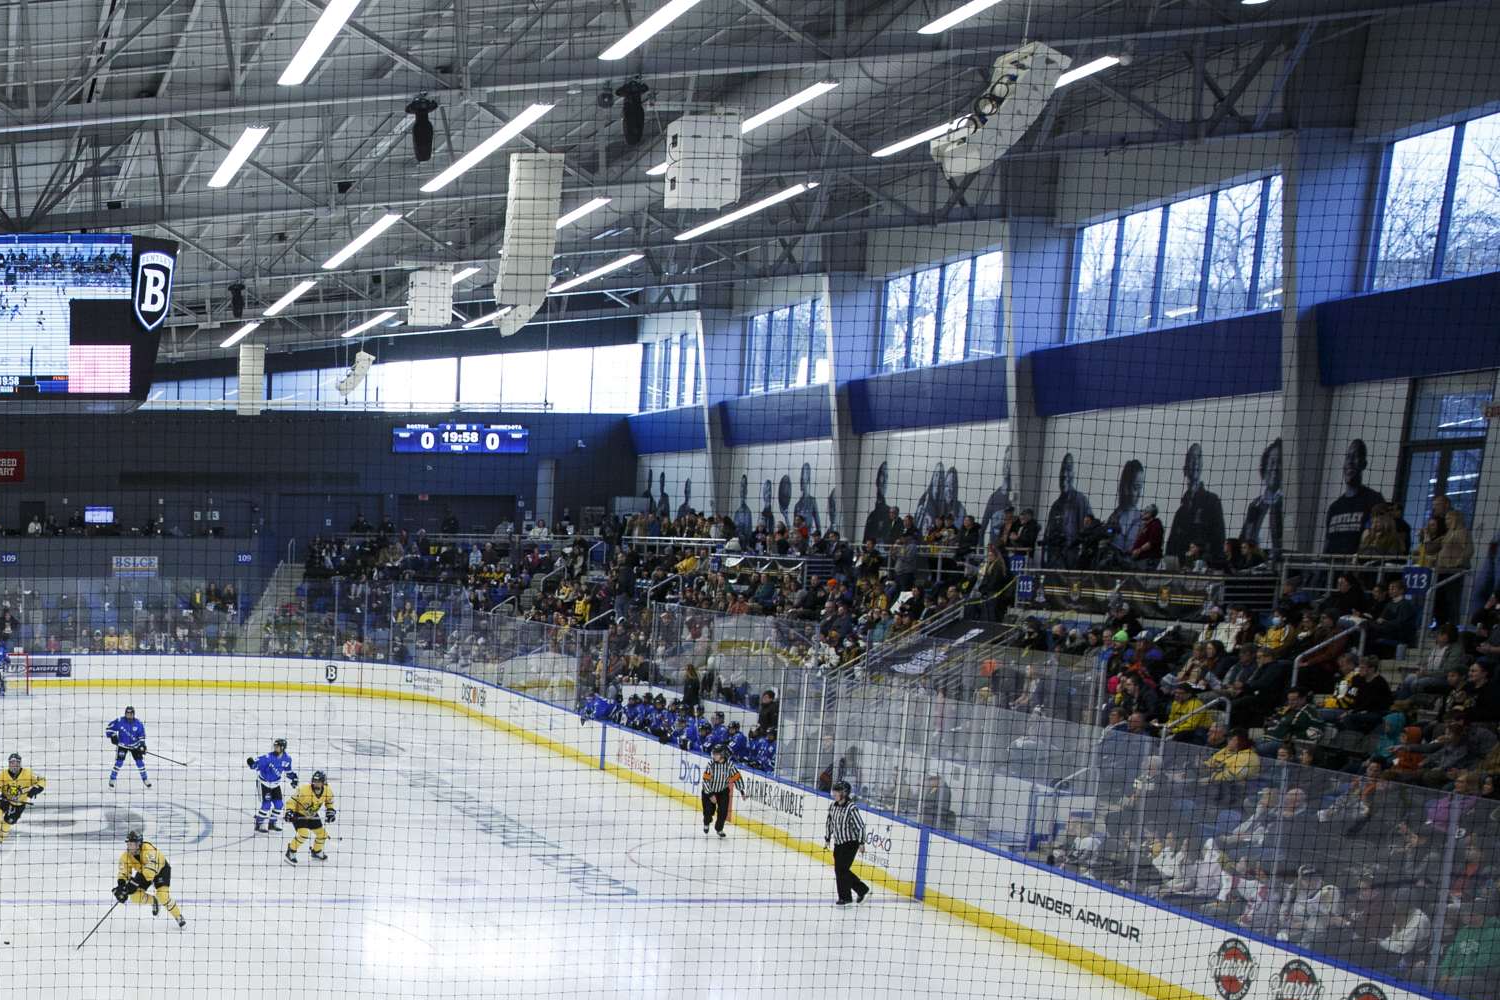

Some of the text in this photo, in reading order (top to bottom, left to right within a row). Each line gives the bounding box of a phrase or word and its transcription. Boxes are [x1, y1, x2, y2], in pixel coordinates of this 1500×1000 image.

[141, 268, 166, 312] B
[421, 431, 435, 449] 0
[442, 432, 479, 442] 19:58
[485, 433, 500, 450] 0
[2, 554, 16, 562] 109
[115, 557, 156, 568] BSLCE
[238, 554, 252, 562] 109
[1019, 581, 1032, 593] 113
[1404, 573, 1428, 589] 113
[625, 741, 637, 754] C&W
[624, 755, 650, 774] SERVICES
[679, 751, 700, 794] bxp
[864, 828, 892, 852] dexo
[145, 850, 157, 862] 13
[1027, 889, 1141, 943] UNDER ARMOUR
[1208, 951, 1260, 984] Harry's
